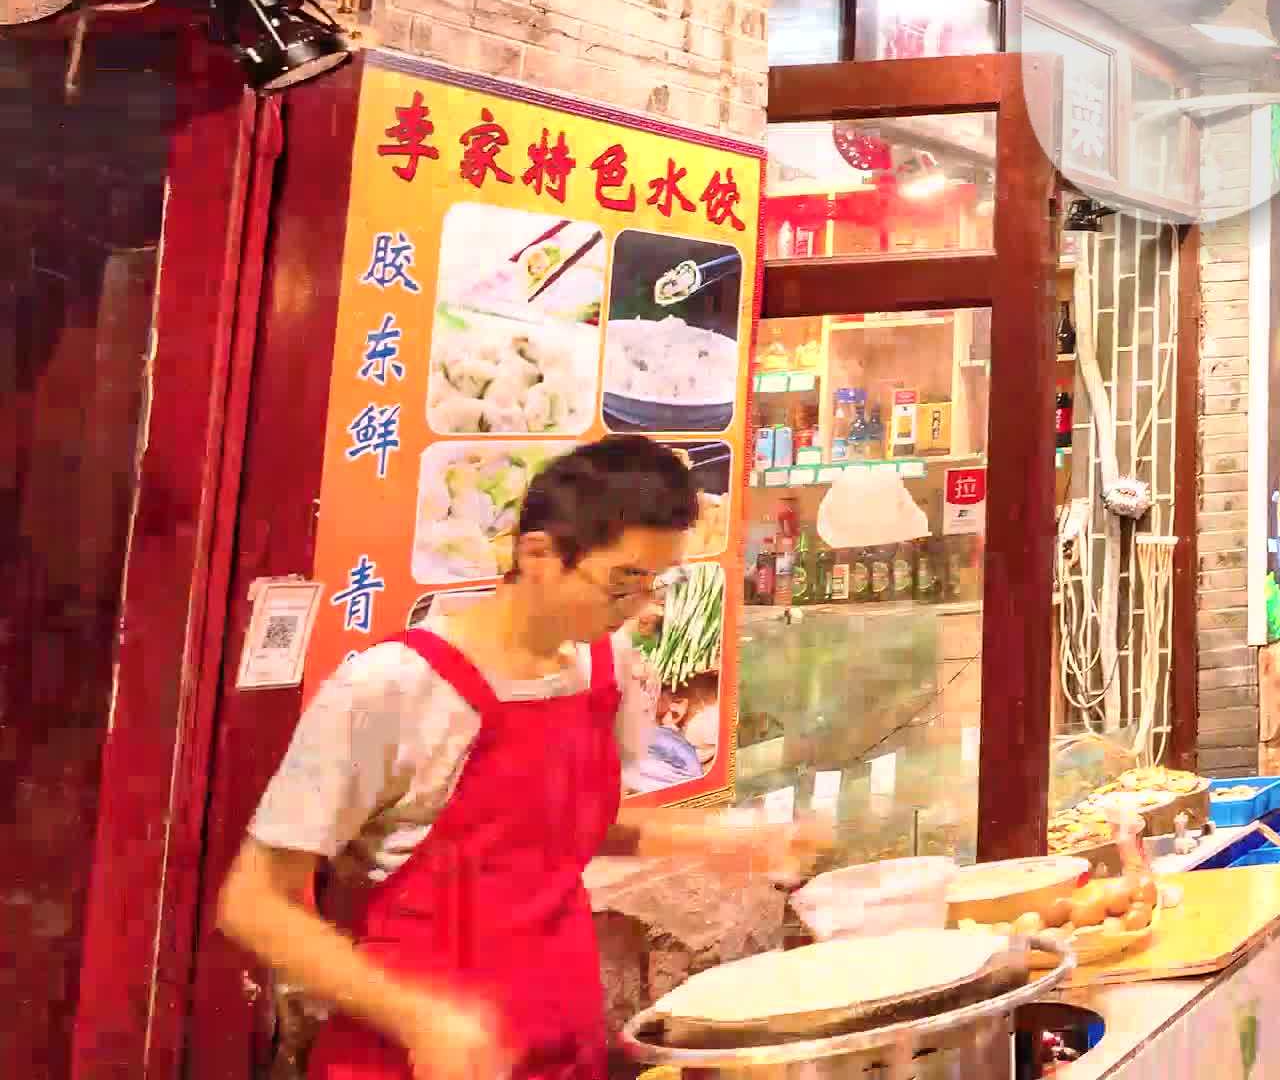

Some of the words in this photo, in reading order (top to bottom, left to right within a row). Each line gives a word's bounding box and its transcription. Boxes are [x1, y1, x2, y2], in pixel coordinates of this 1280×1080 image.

[375, 90, 747, 232] 李家特色水饺
[345, 230, 422, 480] 胶东鲜
[955, 476, 977, 500] 拉
